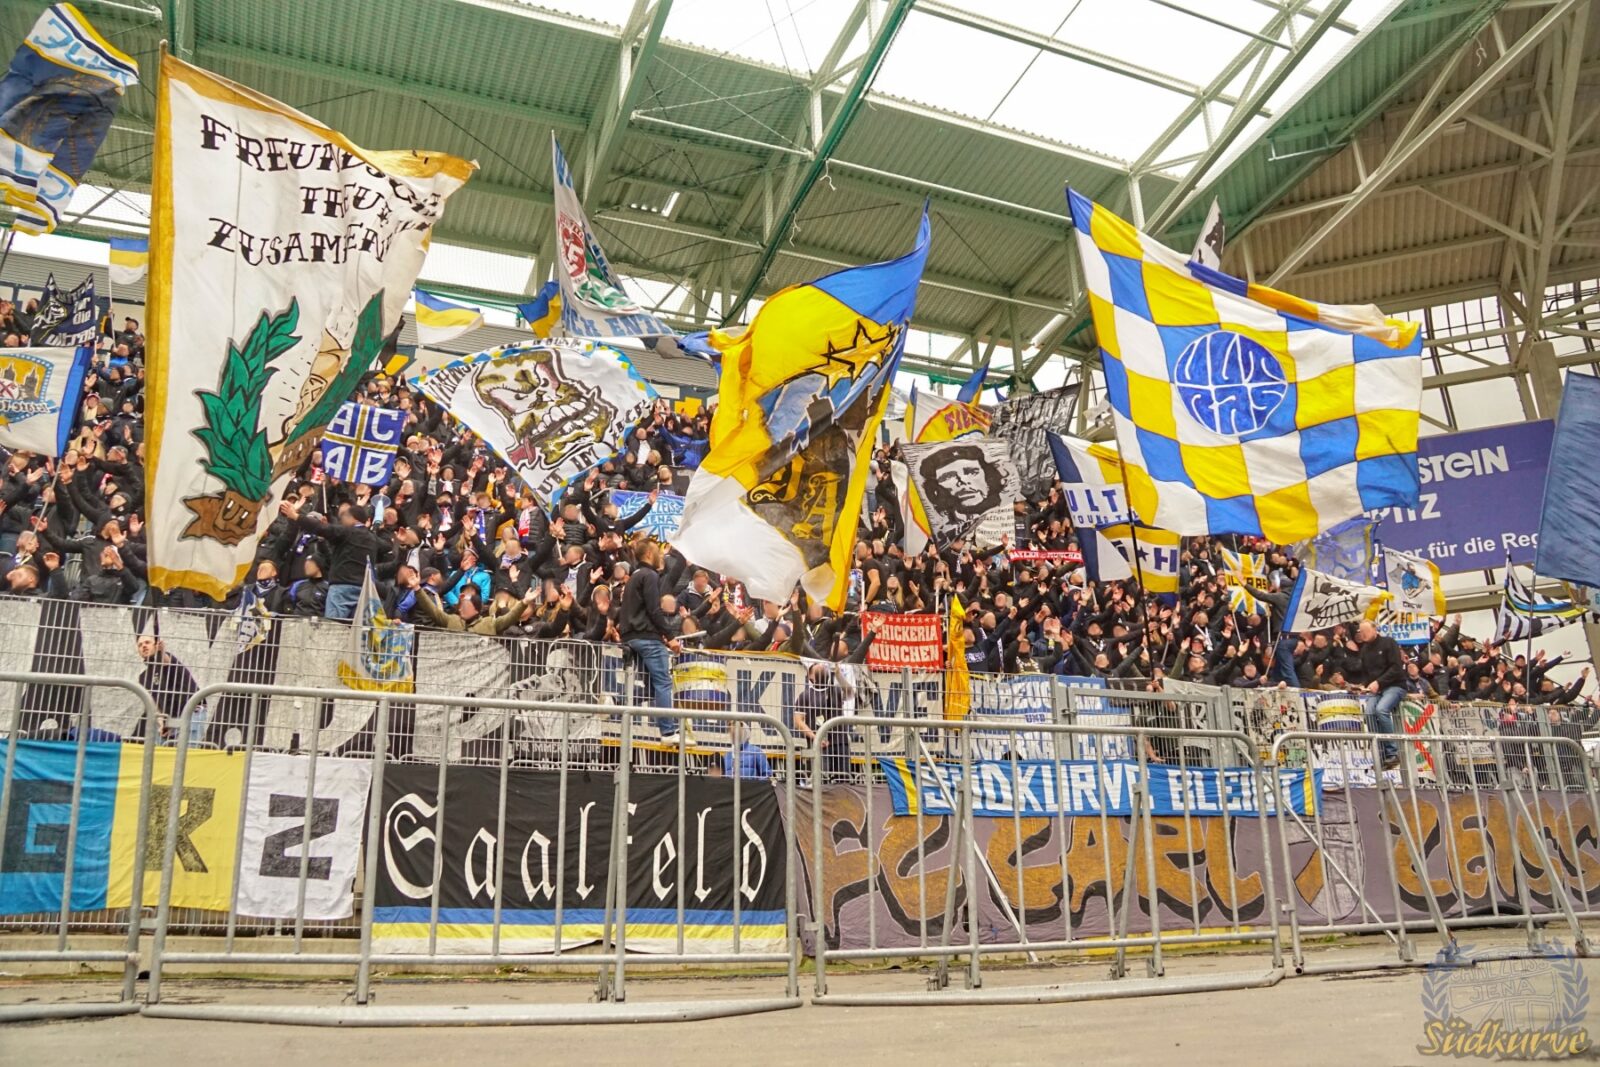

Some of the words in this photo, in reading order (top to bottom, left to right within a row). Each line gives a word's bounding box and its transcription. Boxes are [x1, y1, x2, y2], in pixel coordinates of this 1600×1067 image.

[1427, 541, 1458, 559] für
[1464, 537, 1496, 555] die
[869, 641, 939, 663] MÜNCHEN
[384, 793, 768, 903] Saaleld
